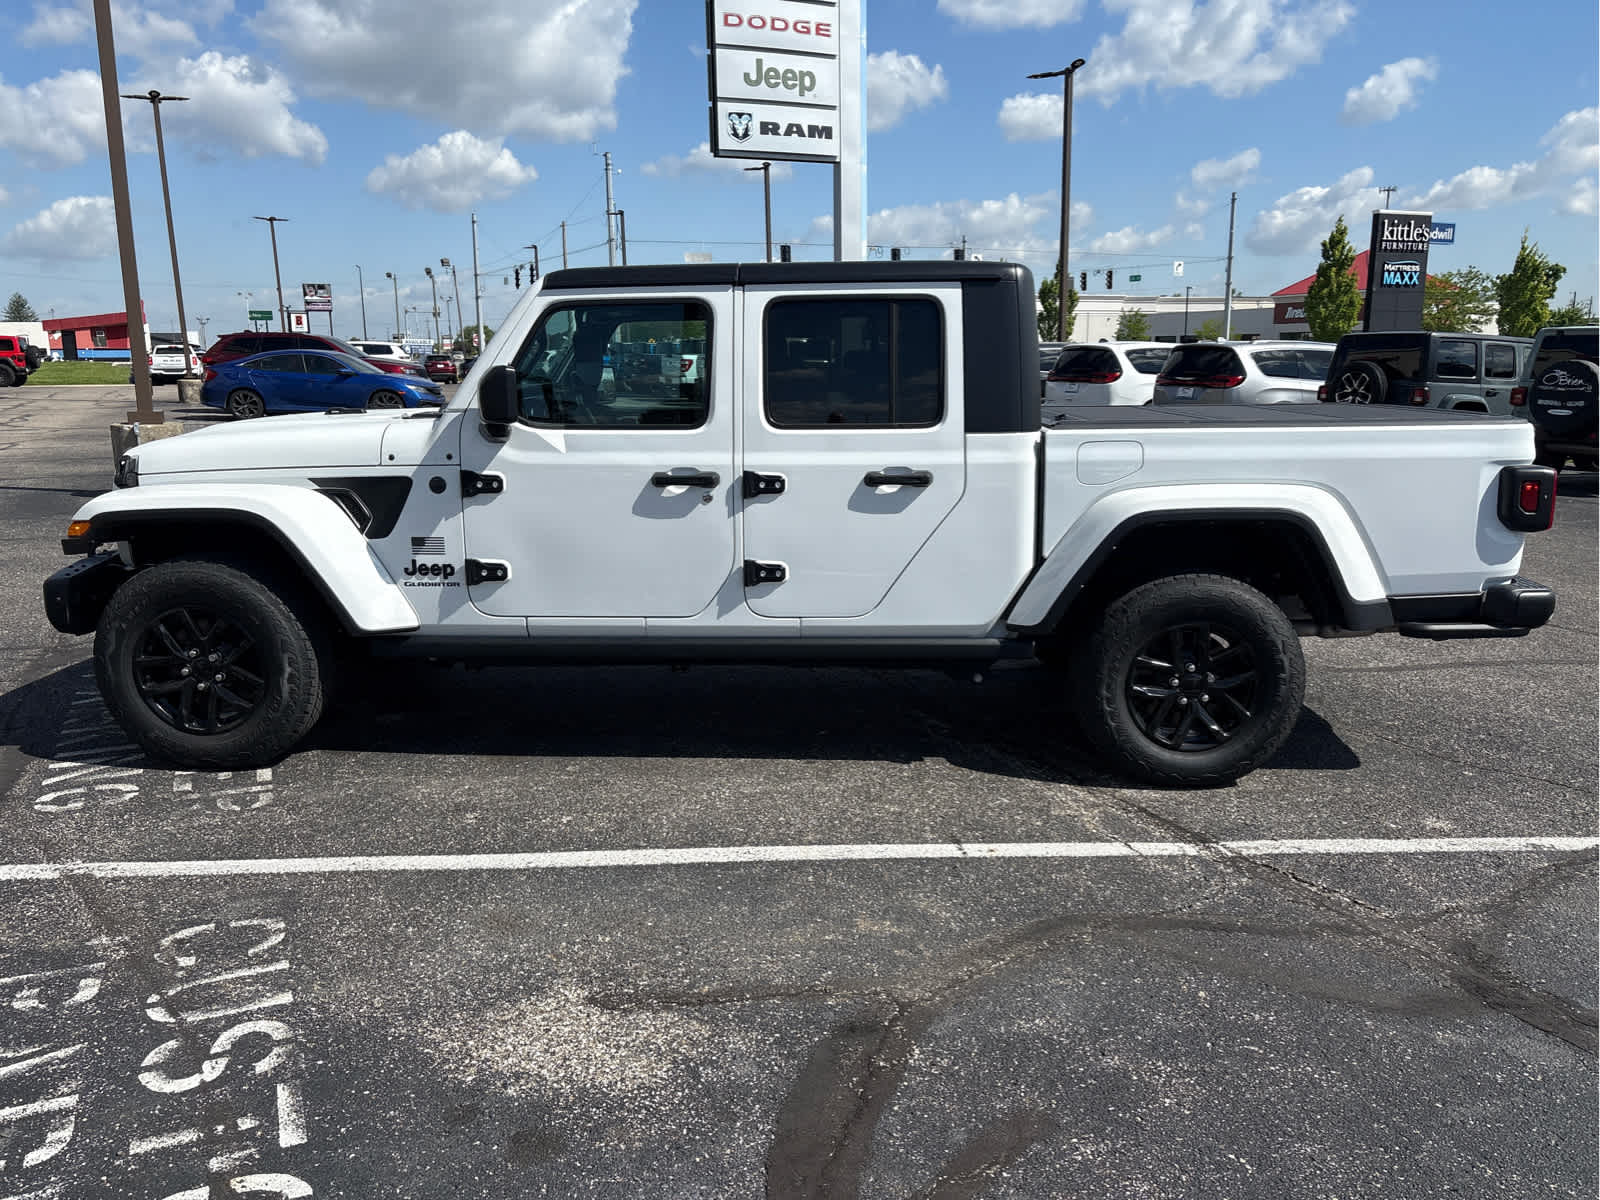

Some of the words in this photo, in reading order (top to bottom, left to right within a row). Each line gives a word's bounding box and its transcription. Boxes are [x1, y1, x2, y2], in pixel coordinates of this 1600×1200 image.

[723, 12, 832, 38] DODGE
[743, 58, 816, 96] Jeep
[759, 121, 833, 140] RAM
[1382, 219, 1430, 242] kittle's
[1382, 241, 1428, 251] FURNITURE
[1384, 264, 1420, 272] MATTRESS
[1383, 272, 1420, 285] MAXX
[404, 559, 455, 580] Jeep
